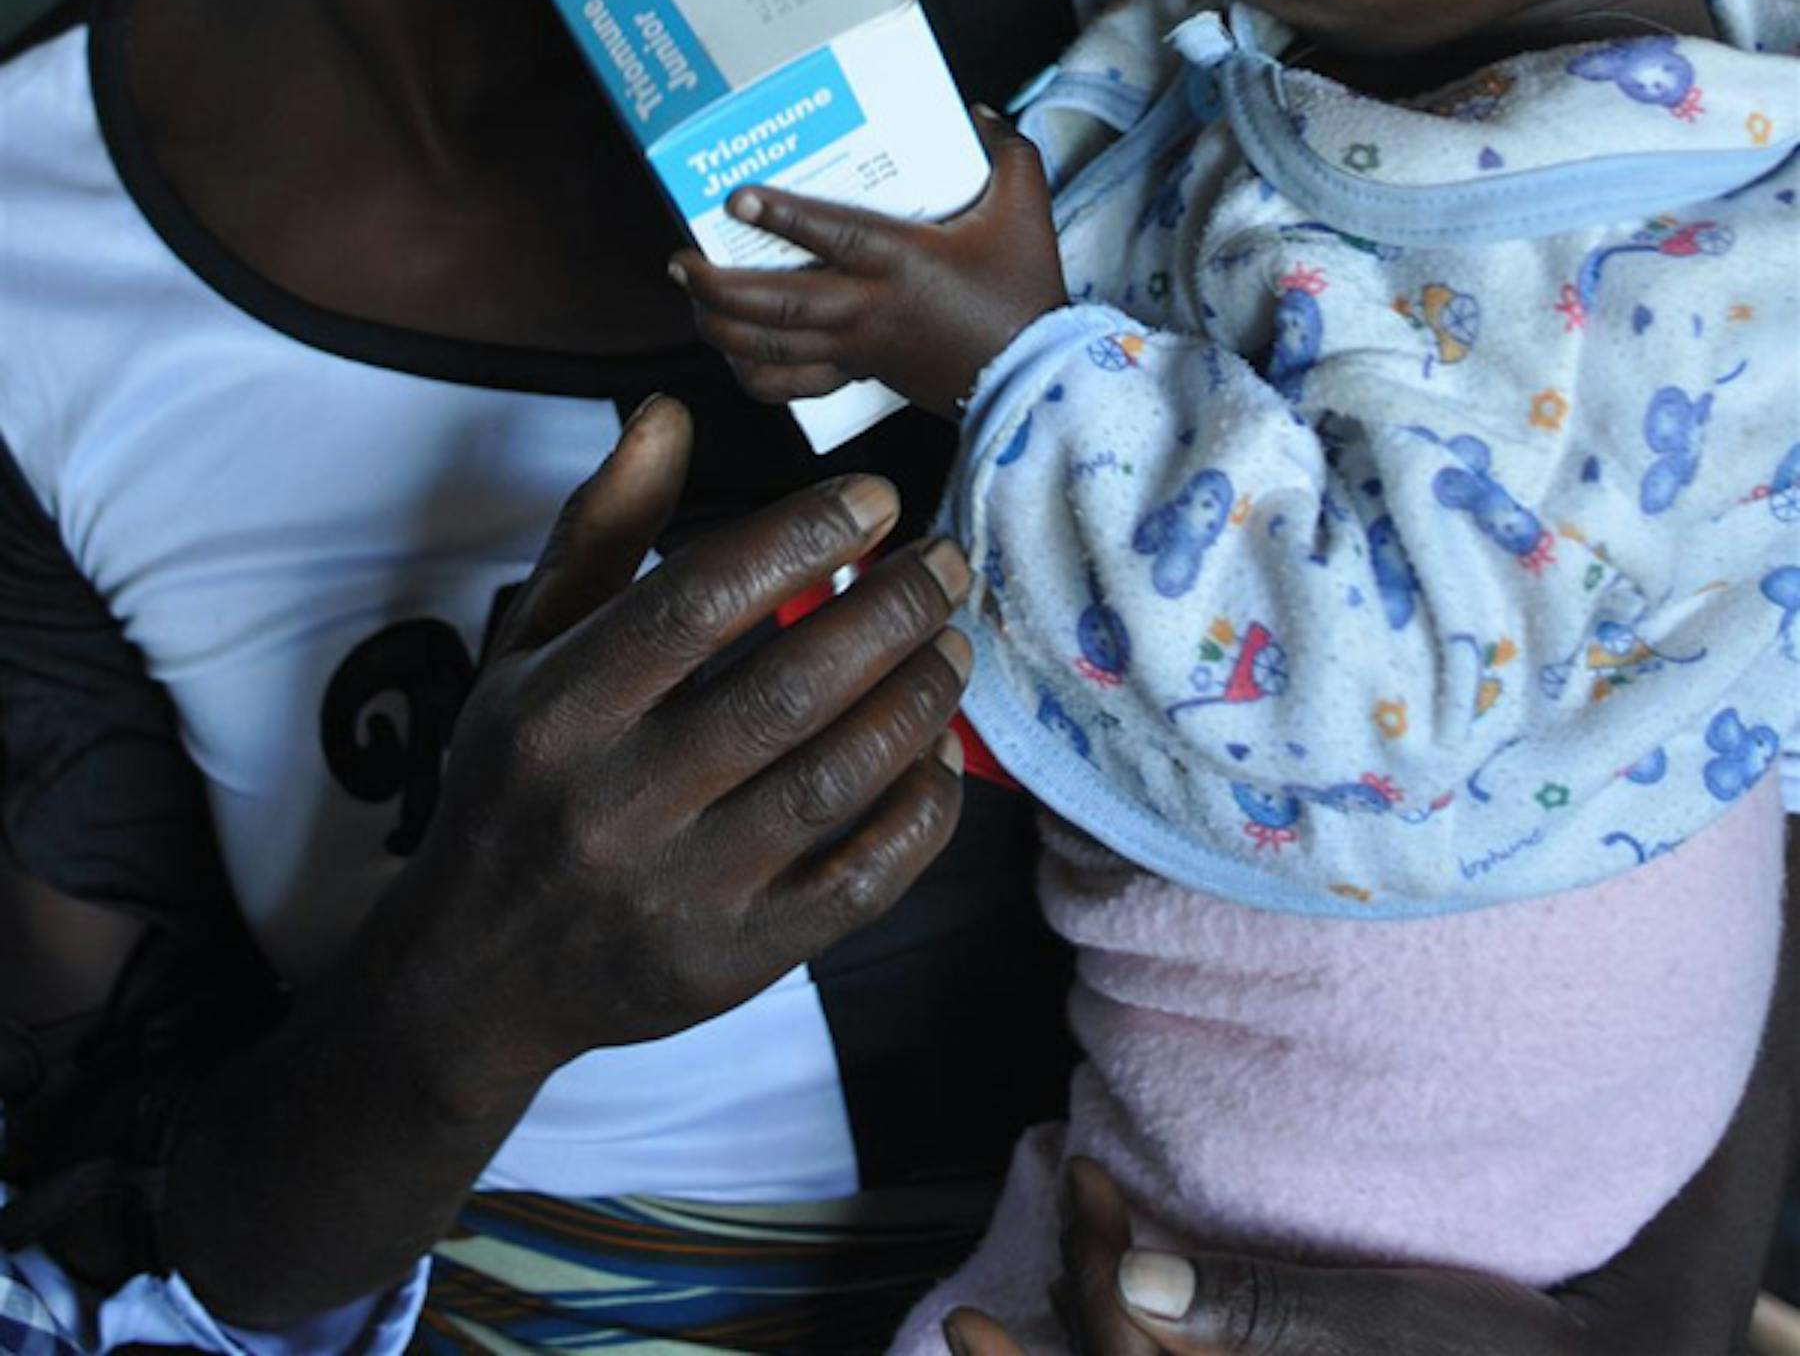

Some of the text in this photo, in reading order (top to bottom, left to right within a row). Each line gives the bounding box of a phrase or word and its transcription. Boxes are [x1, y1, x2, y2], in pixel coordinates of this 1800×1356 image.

[634, 11, 697, 90] Junior
[687, 87, 832, 175] Triomune
[704, 133, 798, 197] Junior
